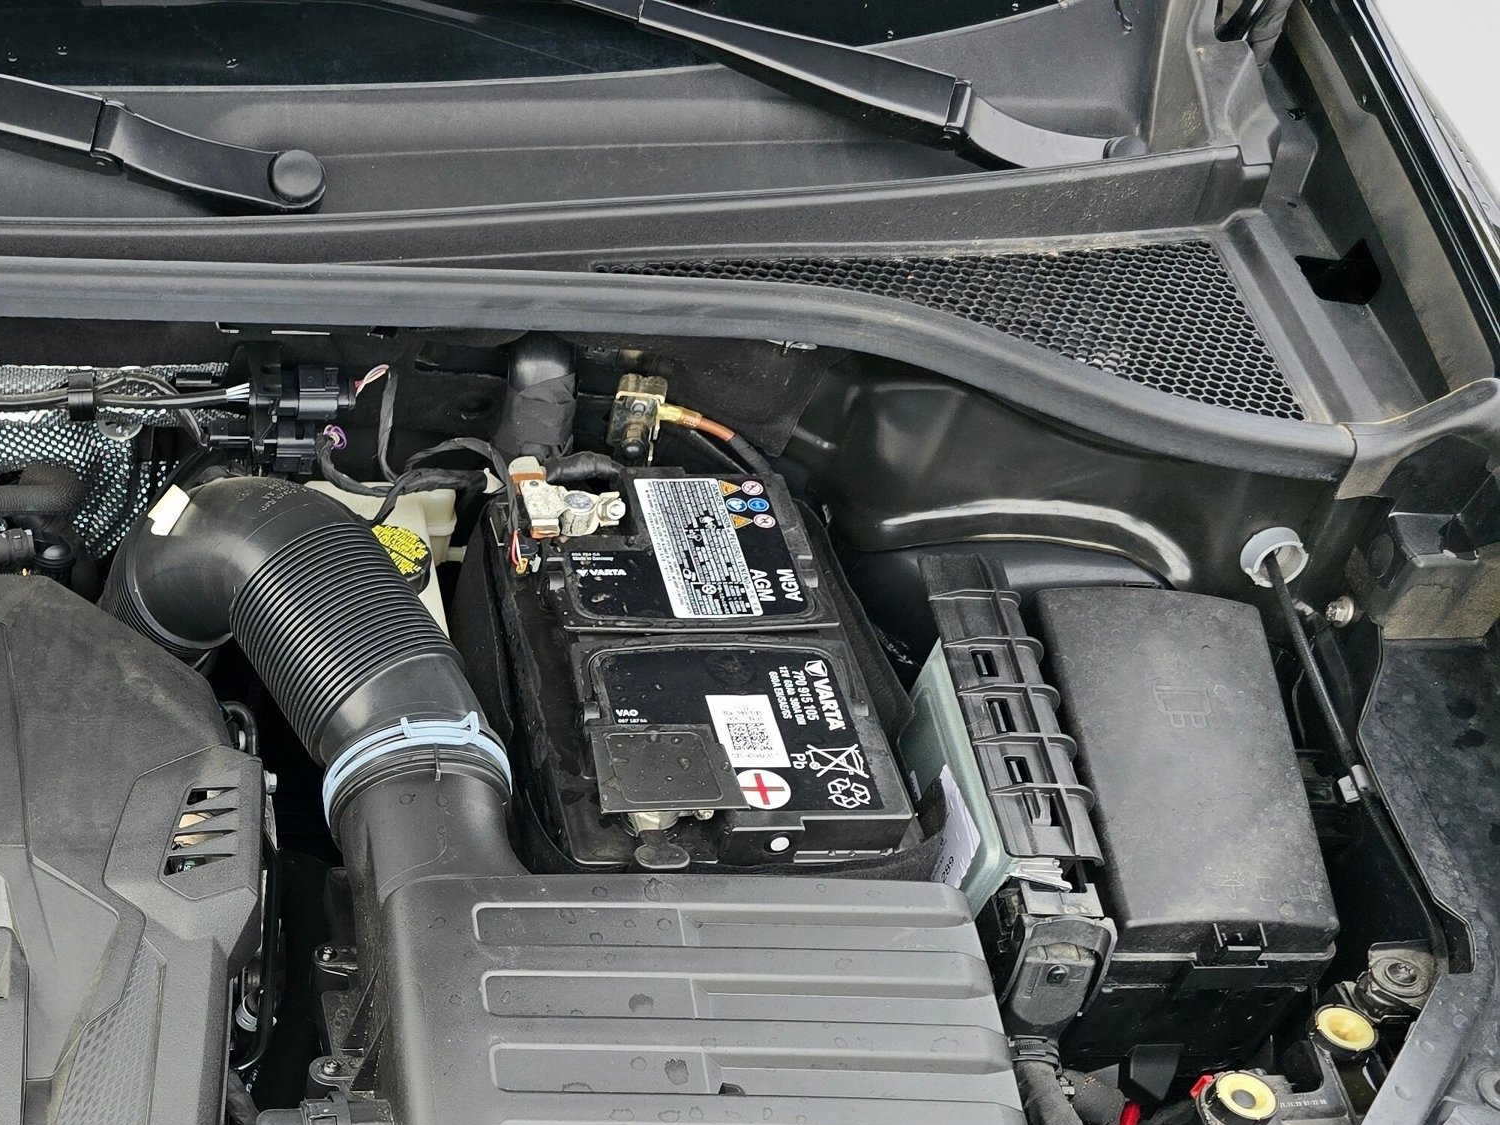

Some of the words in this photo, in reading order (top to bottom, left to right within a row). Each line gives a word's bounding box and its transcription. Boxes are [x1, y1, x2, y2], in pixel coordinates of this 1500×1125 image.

[589, 568, 627, 576] VARTA
[750, 569, 776, 601] AGM
[776, 569, 803, 601] AGM
[797, 687, 814, 703] 915
[803, 705, 820, 721] 105
[813, 677, 846, 732] VARTA
[790, 753, 808, 770] Pb
